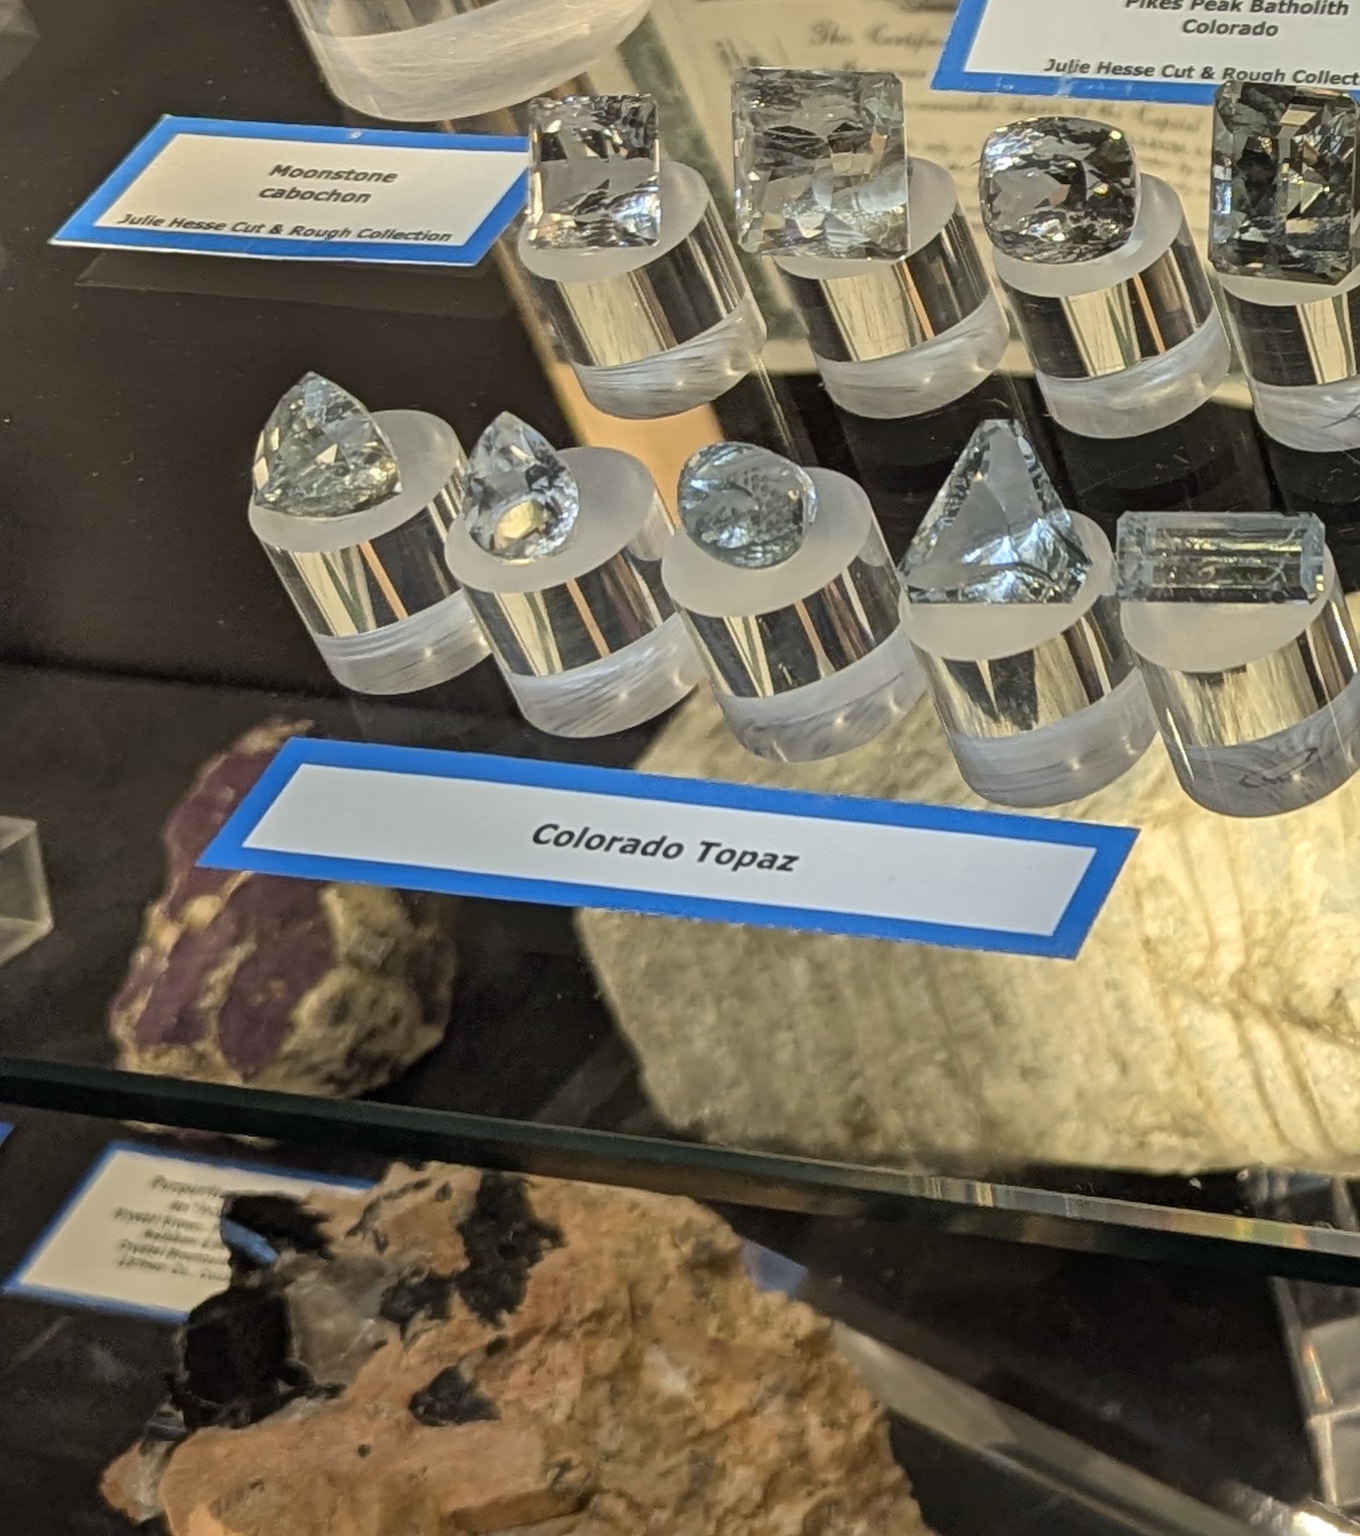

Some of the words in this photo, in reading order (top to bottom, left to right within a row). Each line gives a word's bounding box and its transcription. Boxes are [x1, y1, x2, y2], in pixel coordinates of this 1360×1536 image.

[1181, 19, 1279, 38] Colorado
[1043, 58, 1090, 75] Julie
[1096, 61, 1156, 79] Hesse
[1160, 64, 1196, 81] Cut
[1201, 65, 1216, 82] &
[1221, 66, 1288, 84] Rough
[269, 163, 397, 184] Moonstone
[258, 186, 372, 204] cabochon
[117, 213, 165, 228] Julie
[168, 216, 228, 232] Hesse
[232, 220, 265, 234] Cut
[269, 221, 284, 235] &
[290, 223, 351, 242] Rough
[356, 227, 453, 243] Collection
[532, 823, 684, 860] Colorado
[694, 838, 800, 876] Topaz
